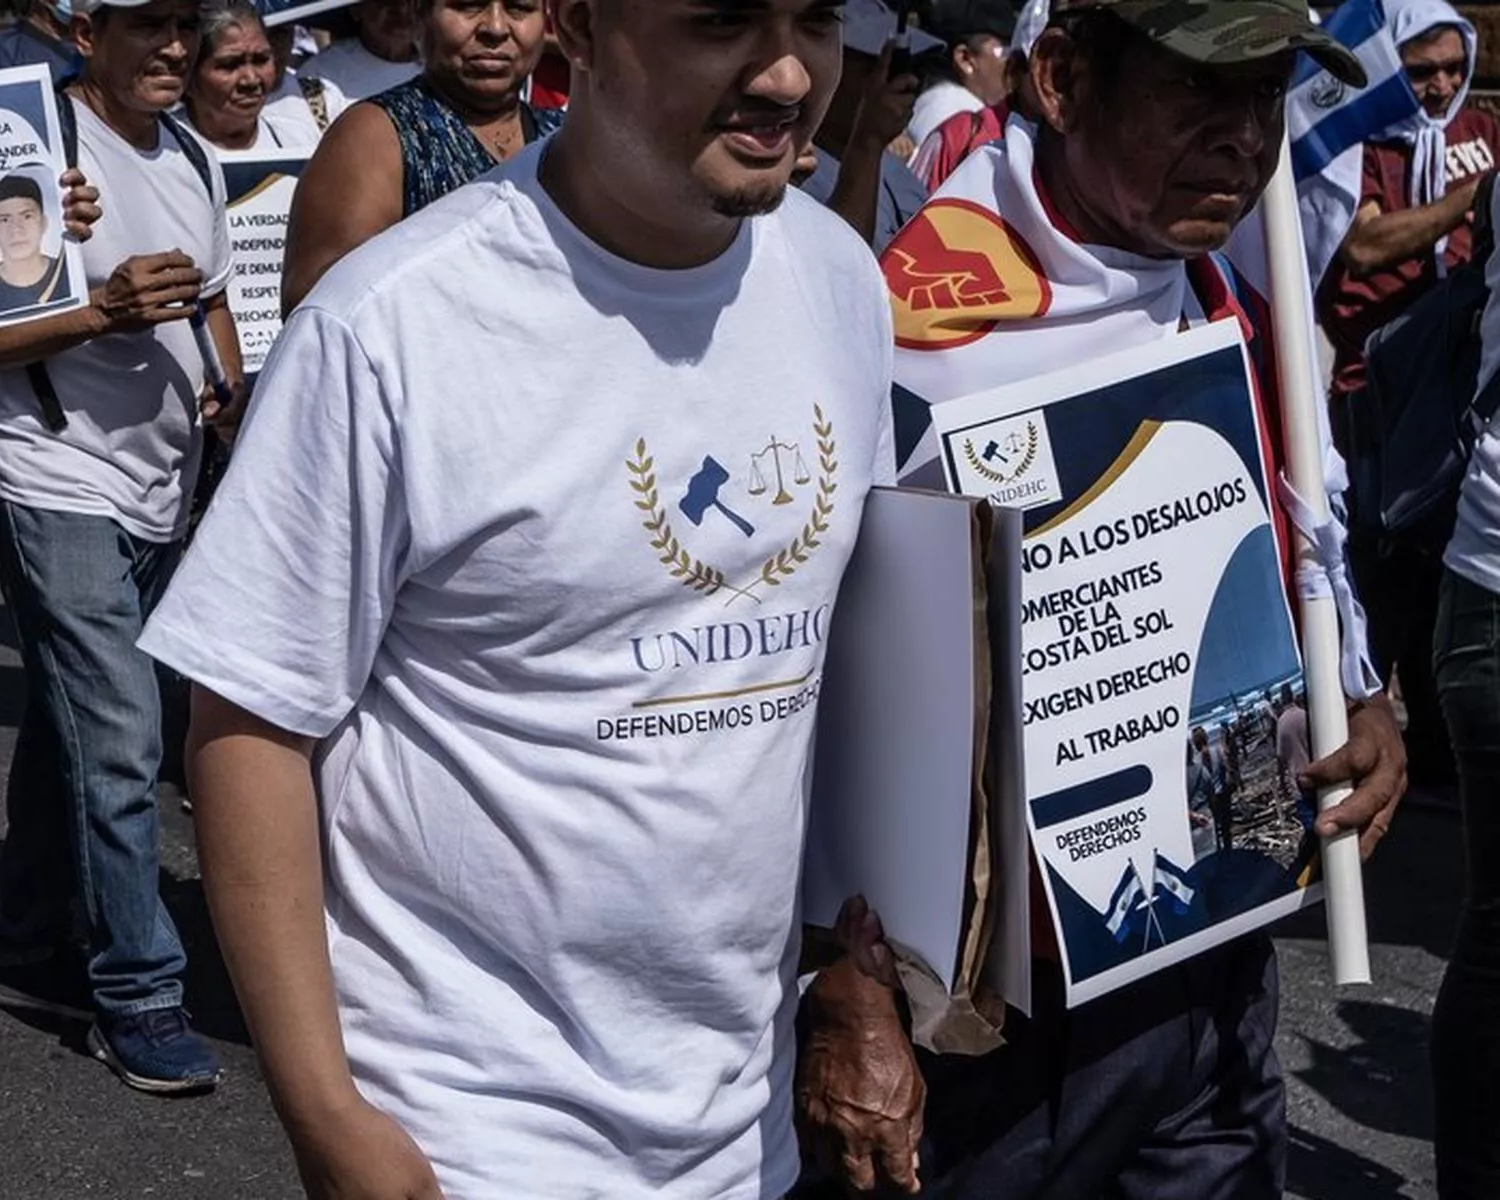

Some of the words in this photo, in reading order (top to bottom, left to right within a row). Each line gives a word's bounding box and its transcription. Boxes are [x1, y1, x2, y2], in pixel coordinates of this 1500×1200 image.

[230, 216, 245, 228] LA
[235, 263, 247, 276] SE
[986, 479, 1047, 504] NIDEHC
[1058, 537, 1079, 564] A
[1080, 519, 1130, 557] LOS
[1131, 478, 1246, 540] DESALOJOS
[1058, 610, 1089, 637] DE
[1091, 601, 1121, 627] LA
[1091, 623, 1131, 653] DEL
[1133, 609, 1173, 640] SOL
[1096, 652, 1191, 702] DERECHO
[597, 704, 754, 740] DEFENDEMOS
[1056, 738, 1084, 766] AL
[1084, 706, 1180, 755] TRABAJO
[1055, 806, 1147, 850] DEFENDEMOS
[1069, 824, 1142, 862] DERECHOS
